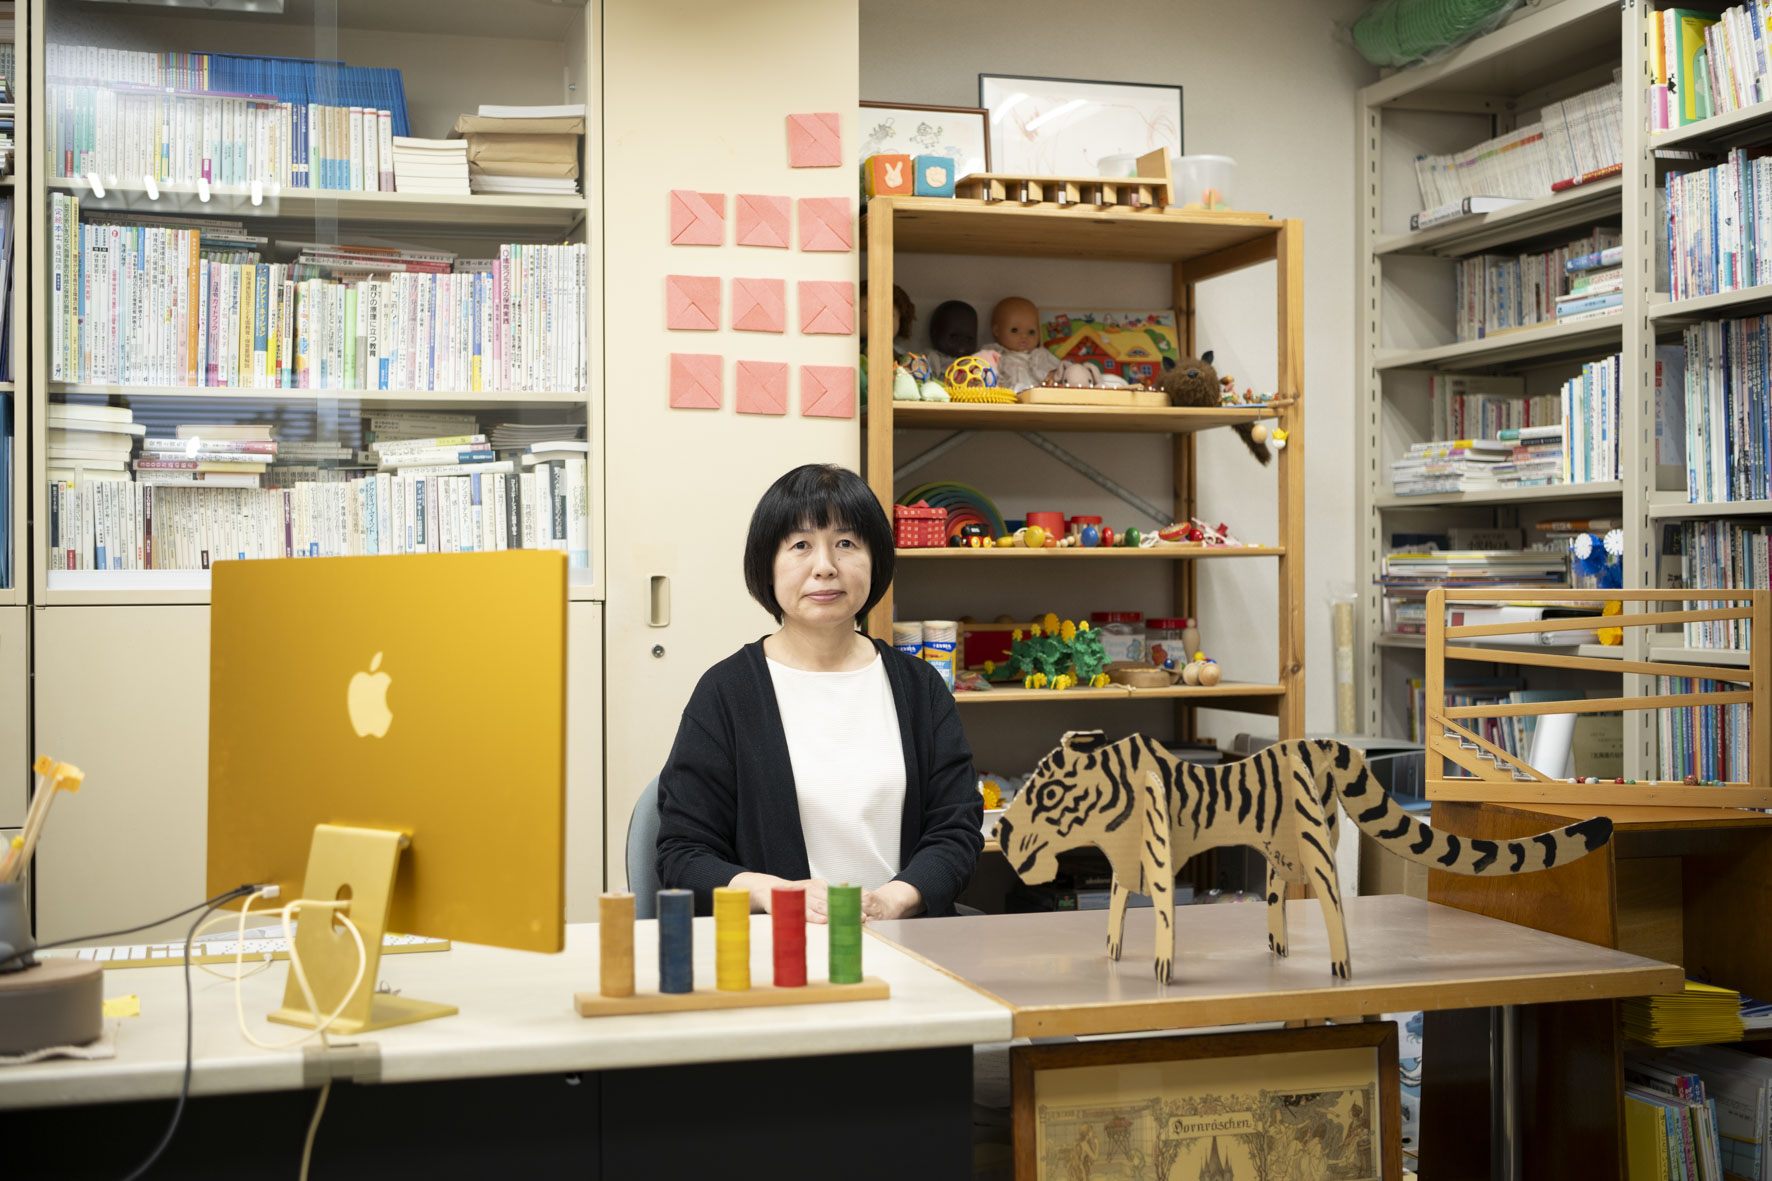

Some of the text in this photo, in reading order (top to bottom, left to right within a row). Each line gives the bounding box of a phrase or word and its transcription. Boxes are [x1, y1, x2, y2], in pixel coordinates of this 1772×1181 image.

[369, 284, 378, 357] 遊びの原理に立つ教育
[368, 481, 376, 536] アクティブ・マインド
[525, 503, 534, 543] 共感の時代へ
